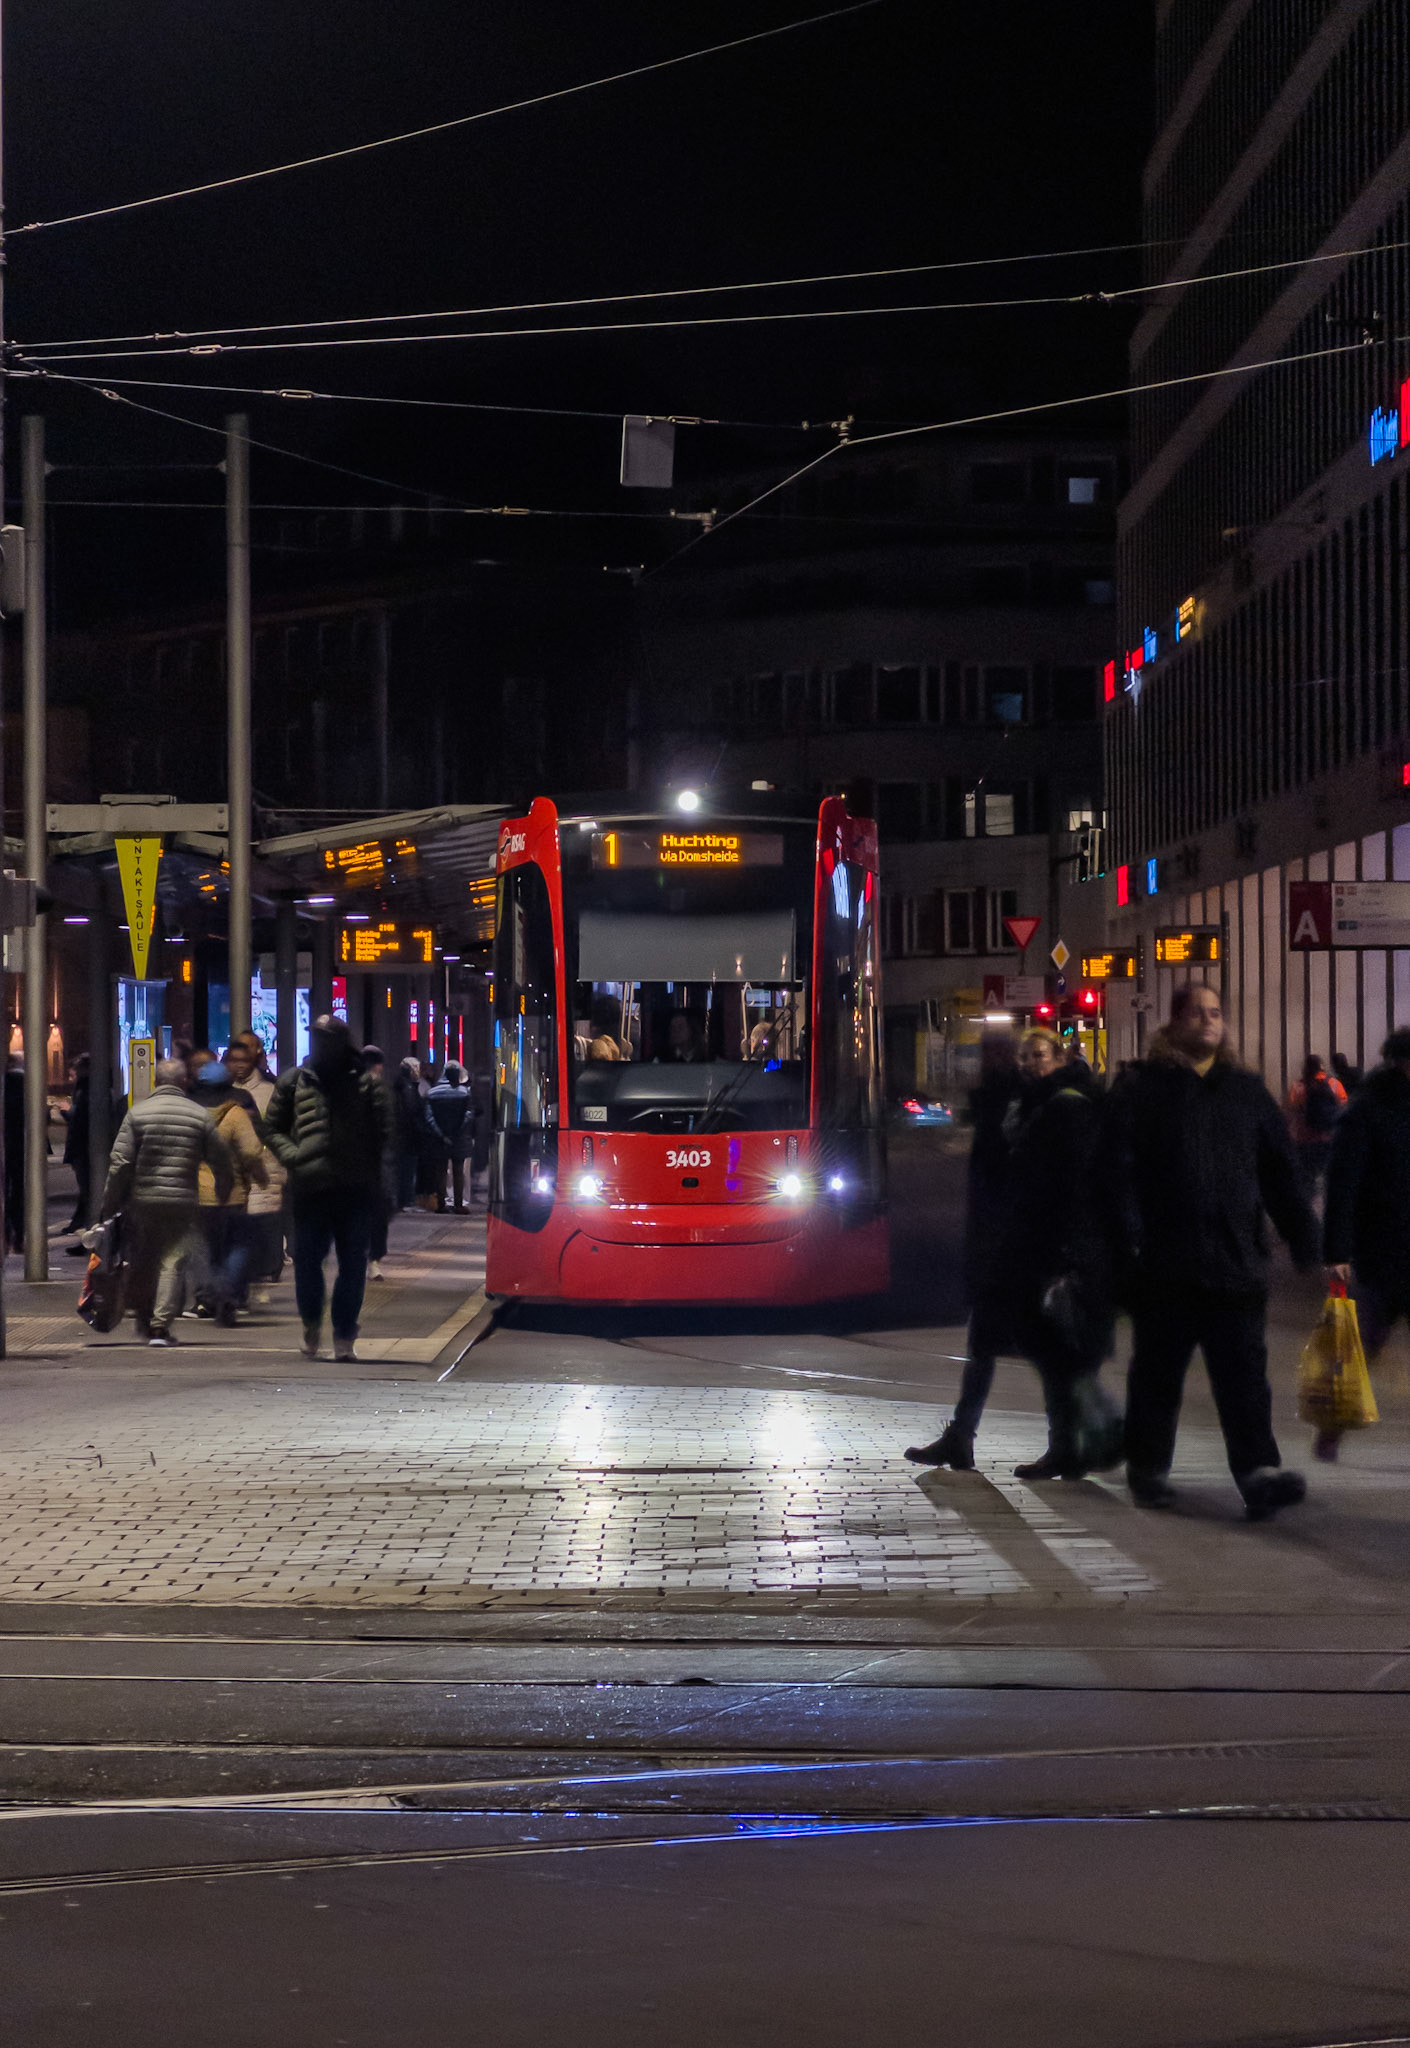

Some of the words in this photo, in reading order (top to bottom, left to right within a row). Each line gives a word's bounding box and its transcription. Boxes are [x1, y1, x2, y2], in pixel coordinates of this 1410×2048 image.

[604, 833, 616, 865] 1
[662, 834, 738, 849] Huchting
[660, 850, 678, 862] via
[679, 850, 739, 862] Domsheide
[133, 836, 145, 952] ONTAKTSÄULE
[1293, 909, 1320, 943] A
[984, 989, 999, 1006] A
[665, 1150, 711, 1167] 3403
